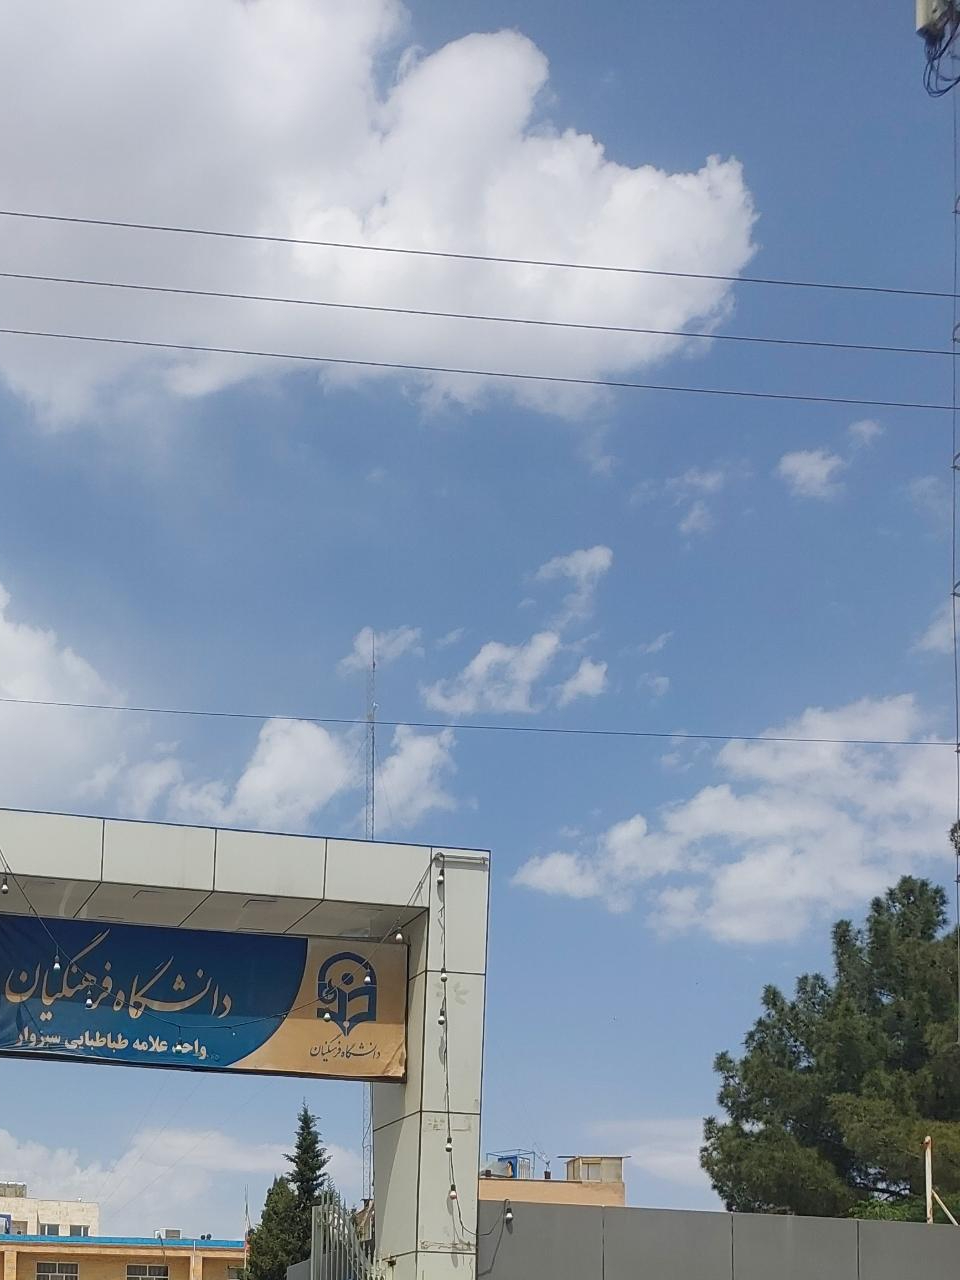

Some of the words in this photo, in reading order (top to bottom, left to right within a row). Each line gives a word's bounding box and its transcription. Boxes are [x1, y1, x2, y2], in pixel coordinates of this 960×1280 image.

[4, 928, 114, 1022] فرهنگیان
[112, 955, 232, 1020] دانشگاه
[15, 1026, 61, 1048] سبزوار
[132, 1034, 168, 1052] علامه
[340, 1042, 381, 1059] دانشگاه
